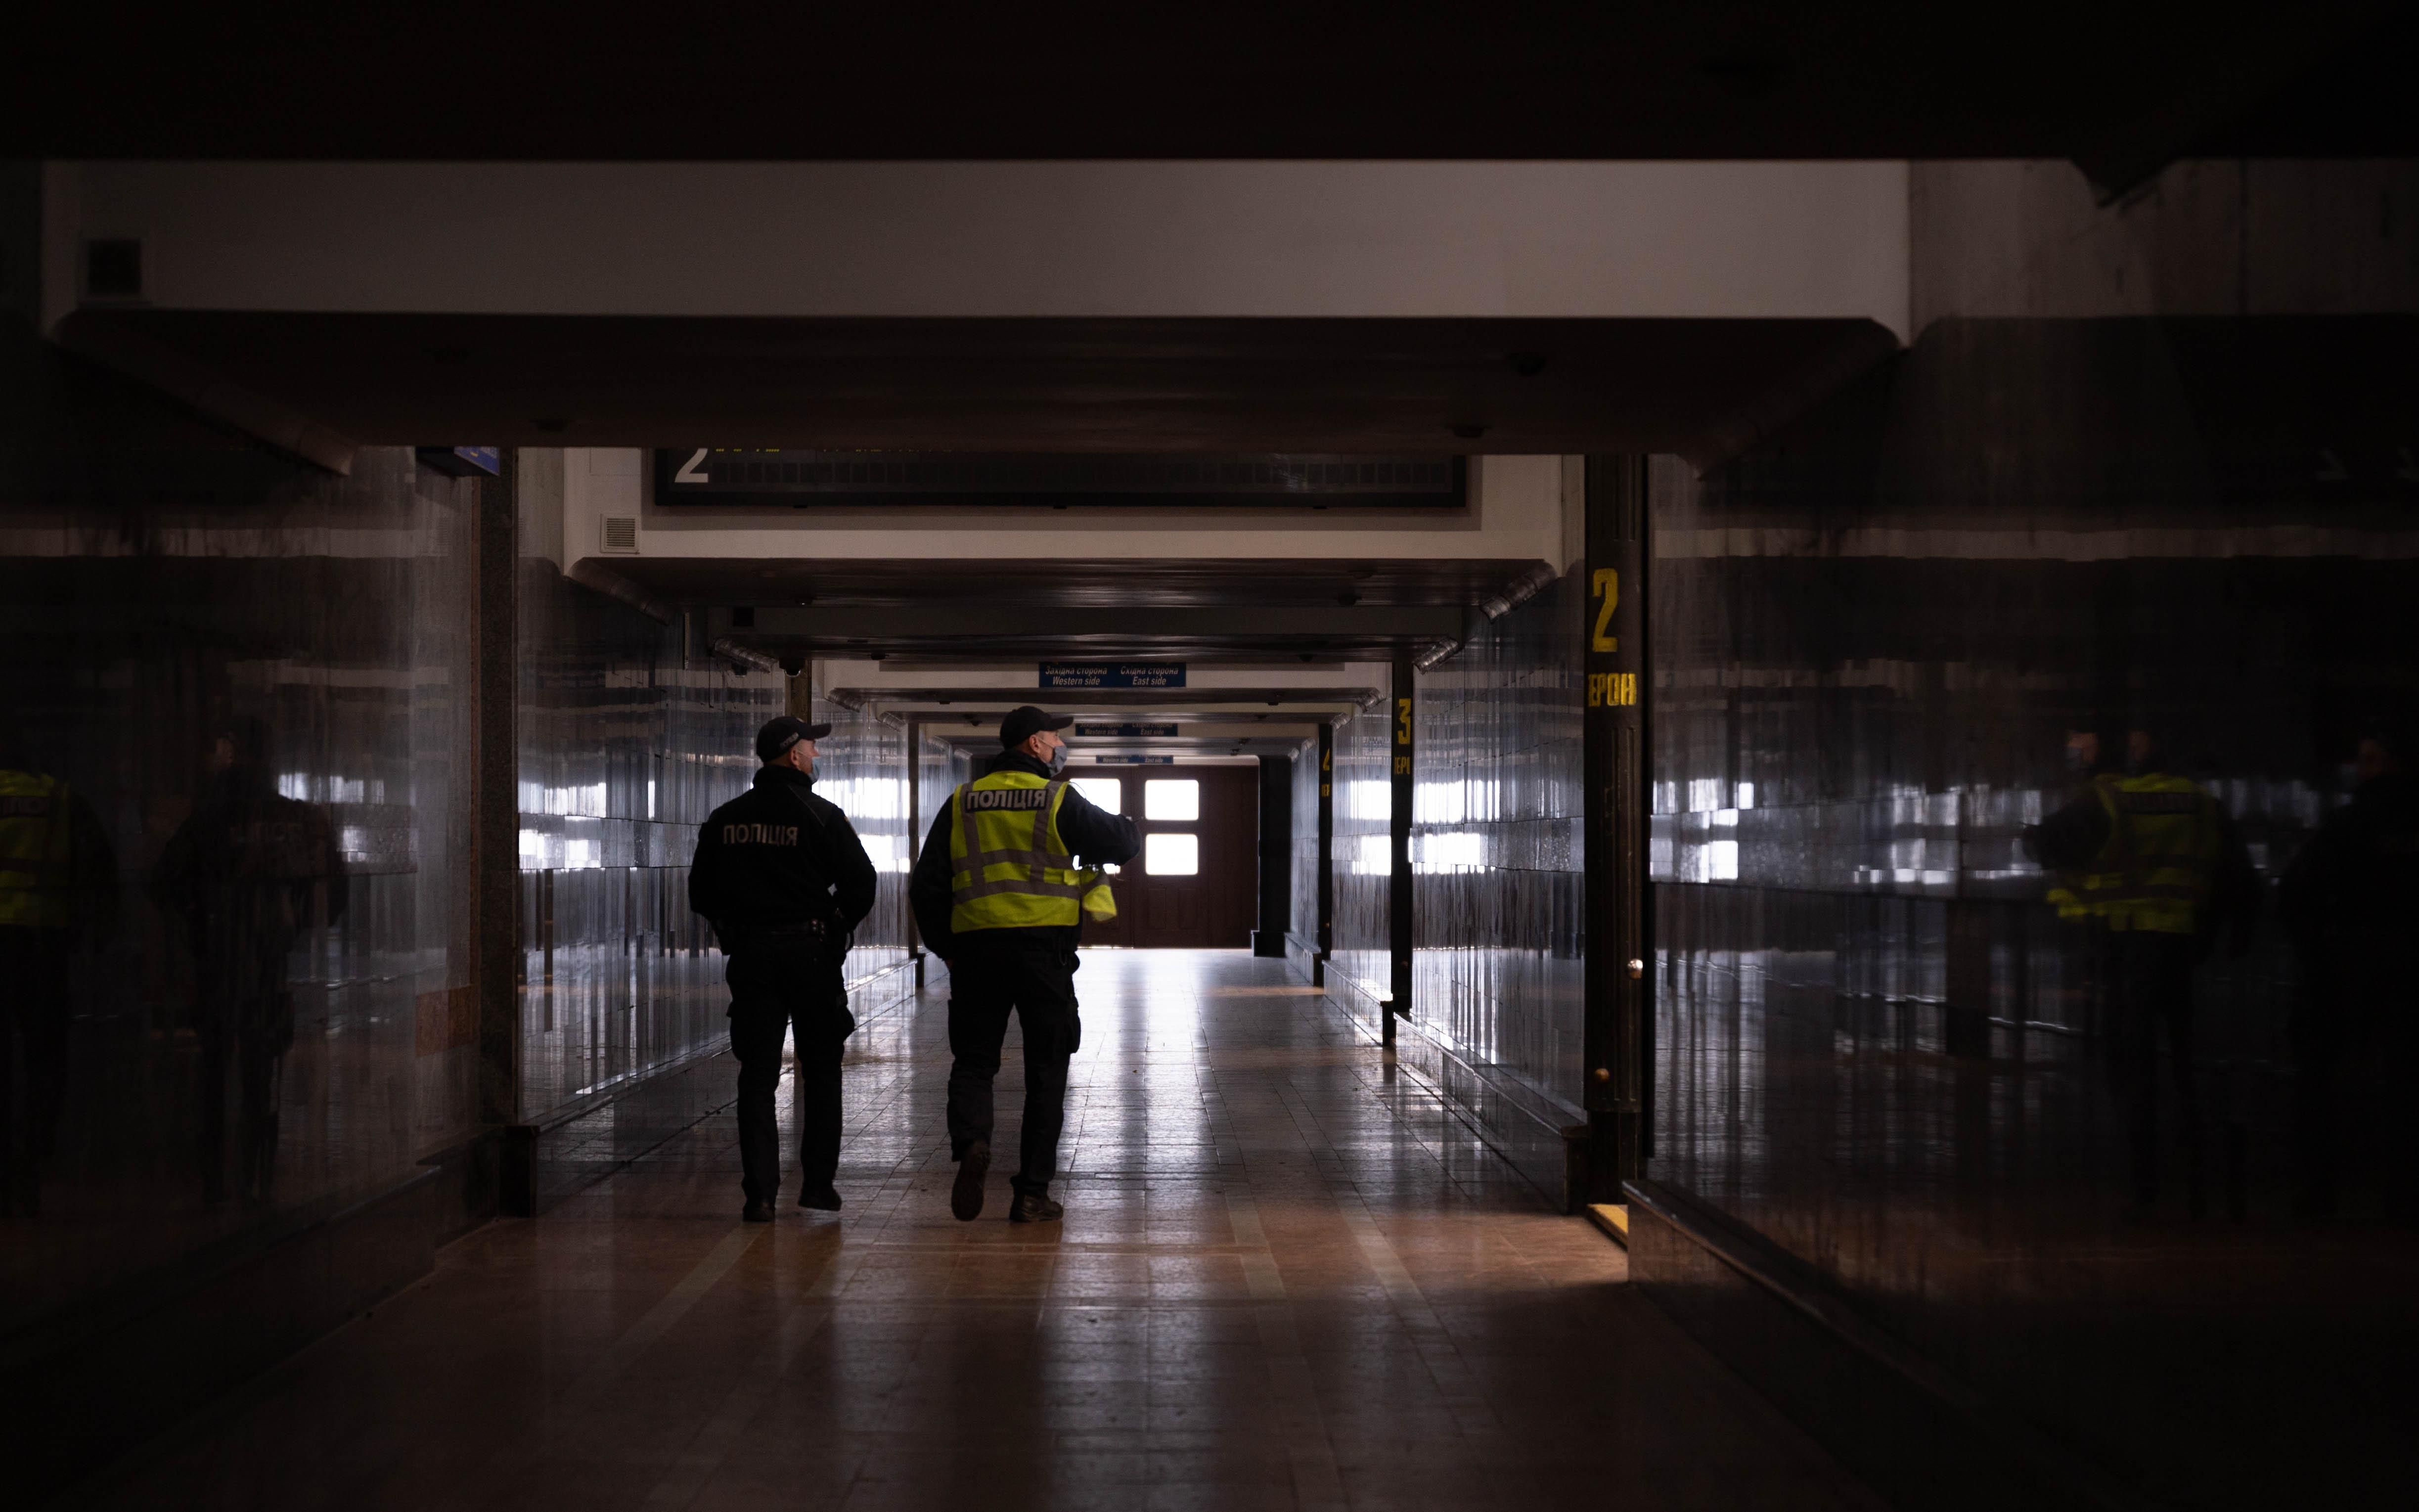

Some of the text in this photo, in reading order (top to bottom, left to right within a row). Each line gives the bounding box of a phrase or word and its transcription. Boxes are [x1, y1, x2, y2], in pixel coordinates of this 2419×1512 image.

[674, 447, 708, 483] 2
[1592, 568, 1618, 653] 2
[1045, 666, 1108, 676] Західна сторона
[1052, 676, 1101, 685] Western side
[1120, 666, 1179, 676] Східна сторона
[1132, 676, 1167, 685] East side
[1396, 698, 1412, 745] 3
[967, 790, 1047, 810] ПОЛІЦІЯ
[722, 823, 799, 846] ПОЛІЦІЯ
